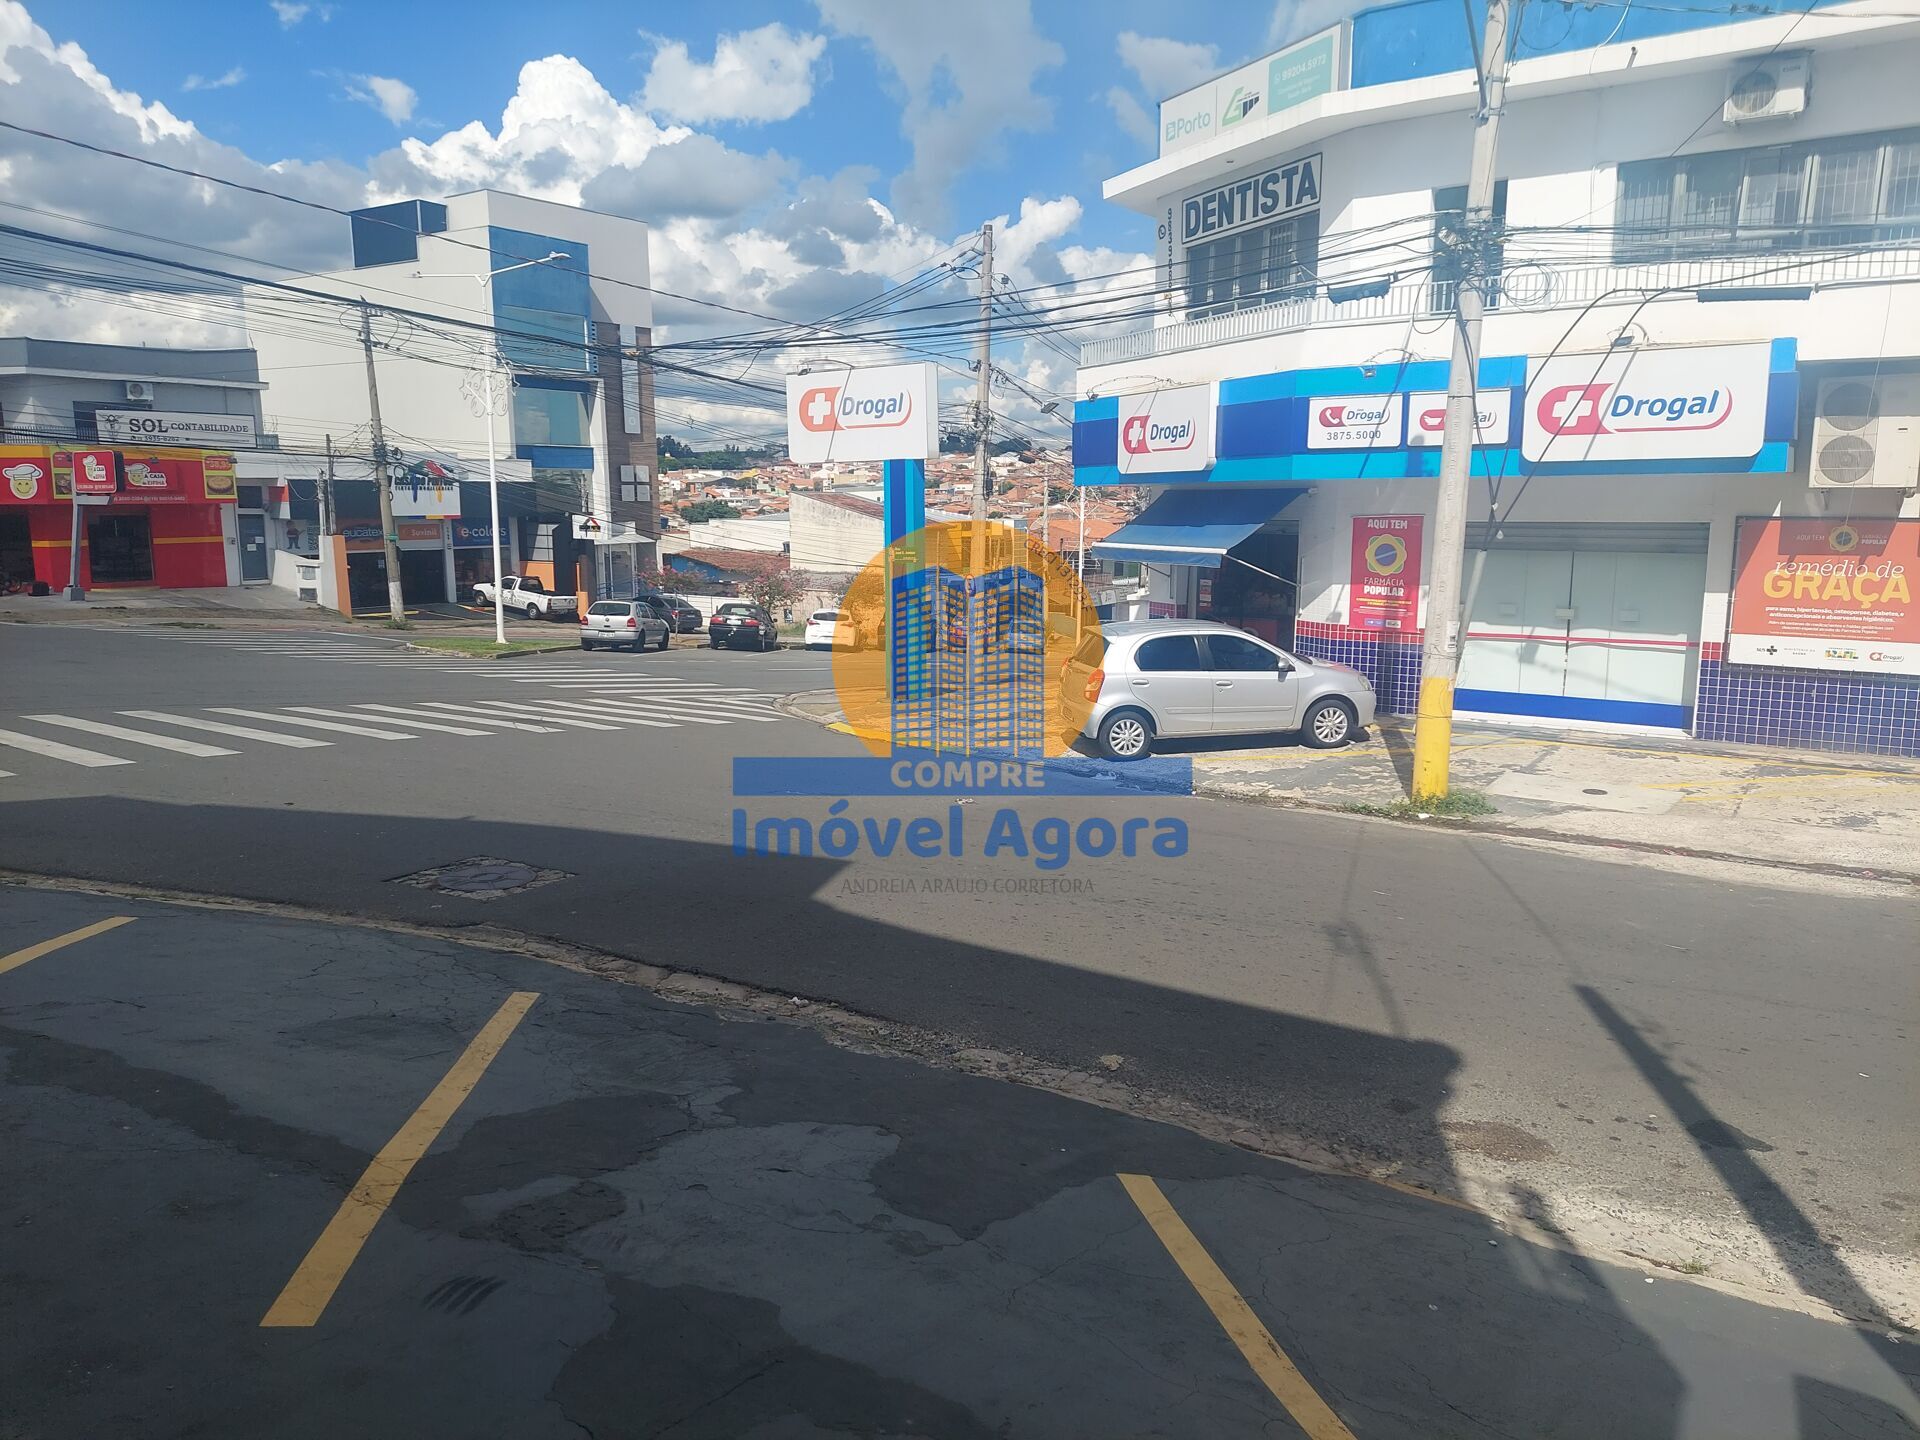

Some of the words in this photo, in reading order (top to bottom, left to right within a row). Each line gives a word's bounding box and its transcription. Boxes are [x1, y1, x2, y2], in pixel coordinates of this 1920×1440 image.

[1177, 112, 1211, 138] Porto
[1185, 161, 1318, 239] DENTISTA
[842, 392, 904, 419] Drogal
[1347, 409, 1386, 421] Drogal
[1611, 389, 1720, 421] Drogal
[129, 418, 168, 433] SOL
[171, 422, 249, 432] CONTABILIDADE
[1149, 423, 1190, 448] Drogal
[1326, 430, 1381, 441] 3875.5000
[1368, 519, 1388, 528] AQUI
[1390, 520, 1408, 529] TEM
[1774, 559, 1868, 578] remédio
[1876, 561, 1905, 579] de
[1364, 576, 1405, 586] FARMÁCIA
[1763, 569, 1911, 609] GRAÇA
[1364, 586, 1404, 597] POPULAR
